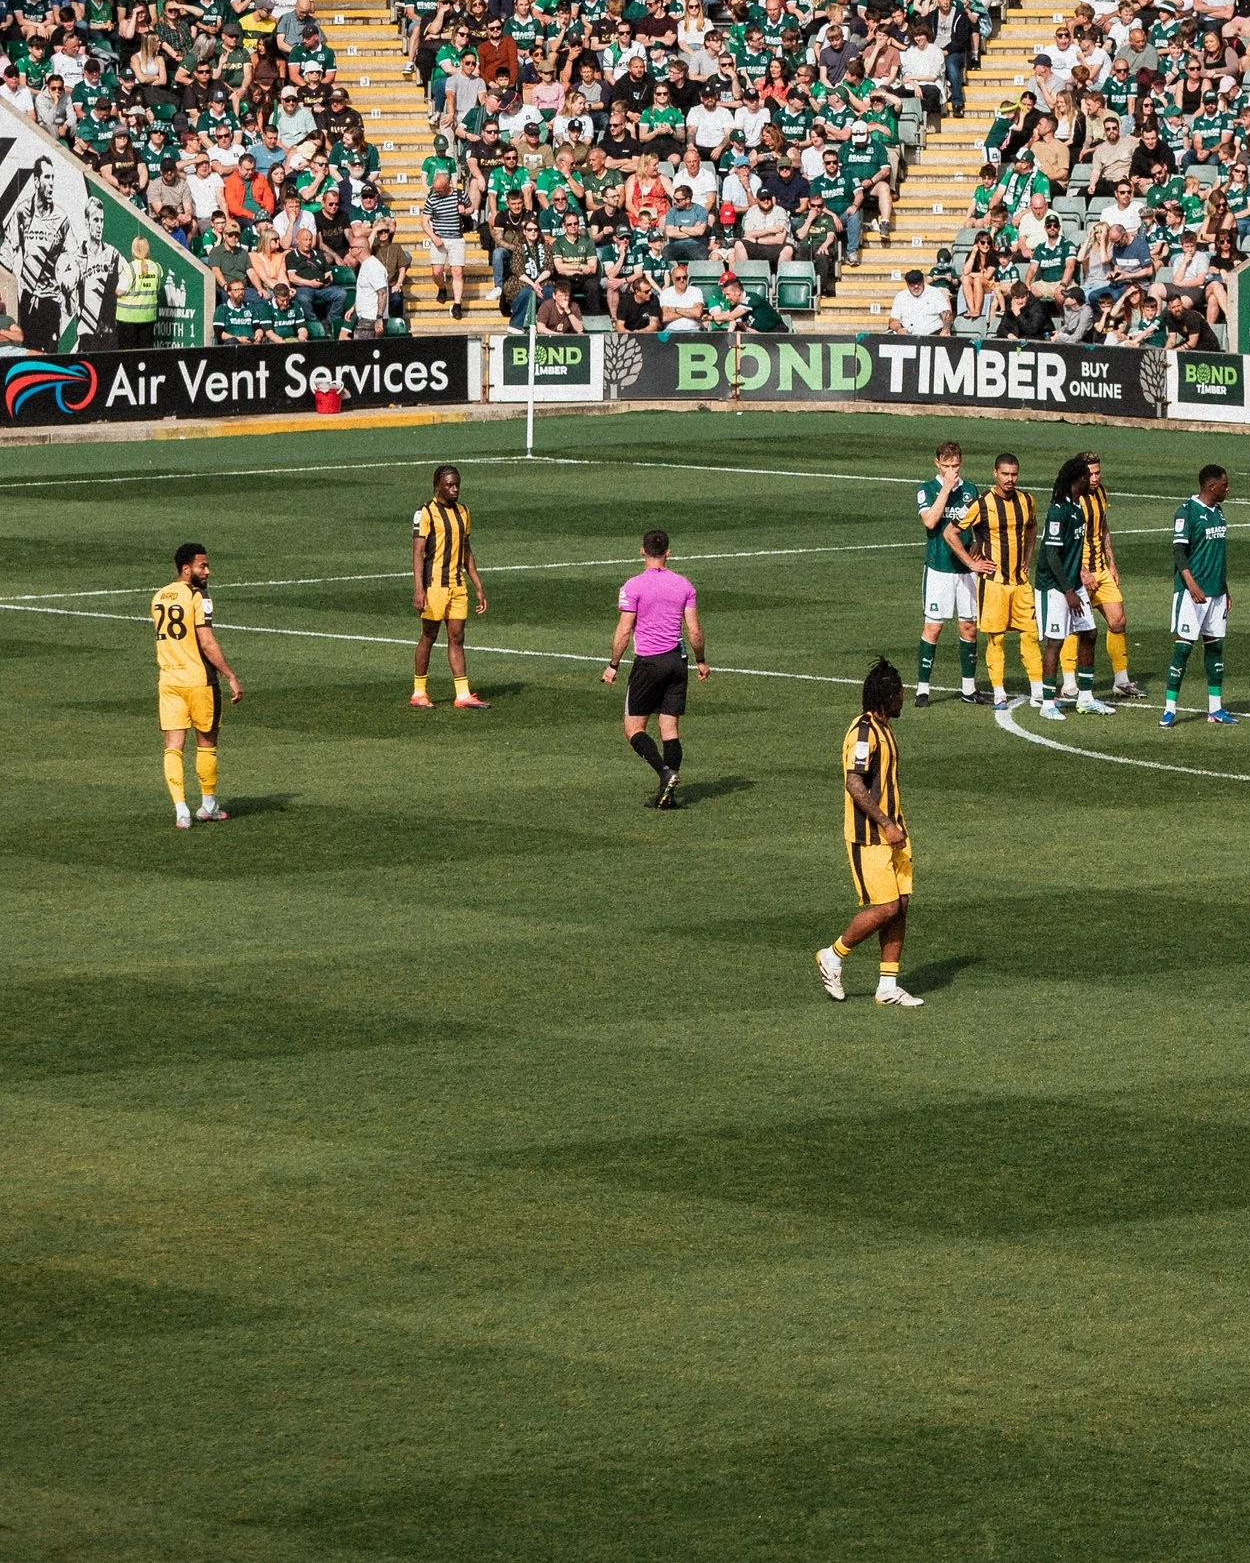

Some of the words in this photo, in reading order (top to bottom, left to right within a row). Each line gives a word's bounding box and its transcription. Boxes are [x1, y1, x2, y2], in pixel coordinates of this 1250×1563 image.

[158, 308, 196, 319] WEMBLEY
[153, 322, 184, 337] MOUTH
[190, 322, 195, 337] 1
[512, 345, 583, 366] BOND
[106, 362, 166, 407] Air
[178, 359, 269, 403] Vent
[284, 349, 449, 398] Services
[528, 364, 568, 376] IMBER
[674, 343, 873, 392] BOND
[878, 344, 1067, 403] TIMBER
[1081, 361, 1110, 379] BUY
[1184, 363, 1238, 385] BOND
[1069, 380, 1122, 400] ONLINE
[1195, 382, 1227, 395] TIMBER
[154, 603, 187, 640] 28
